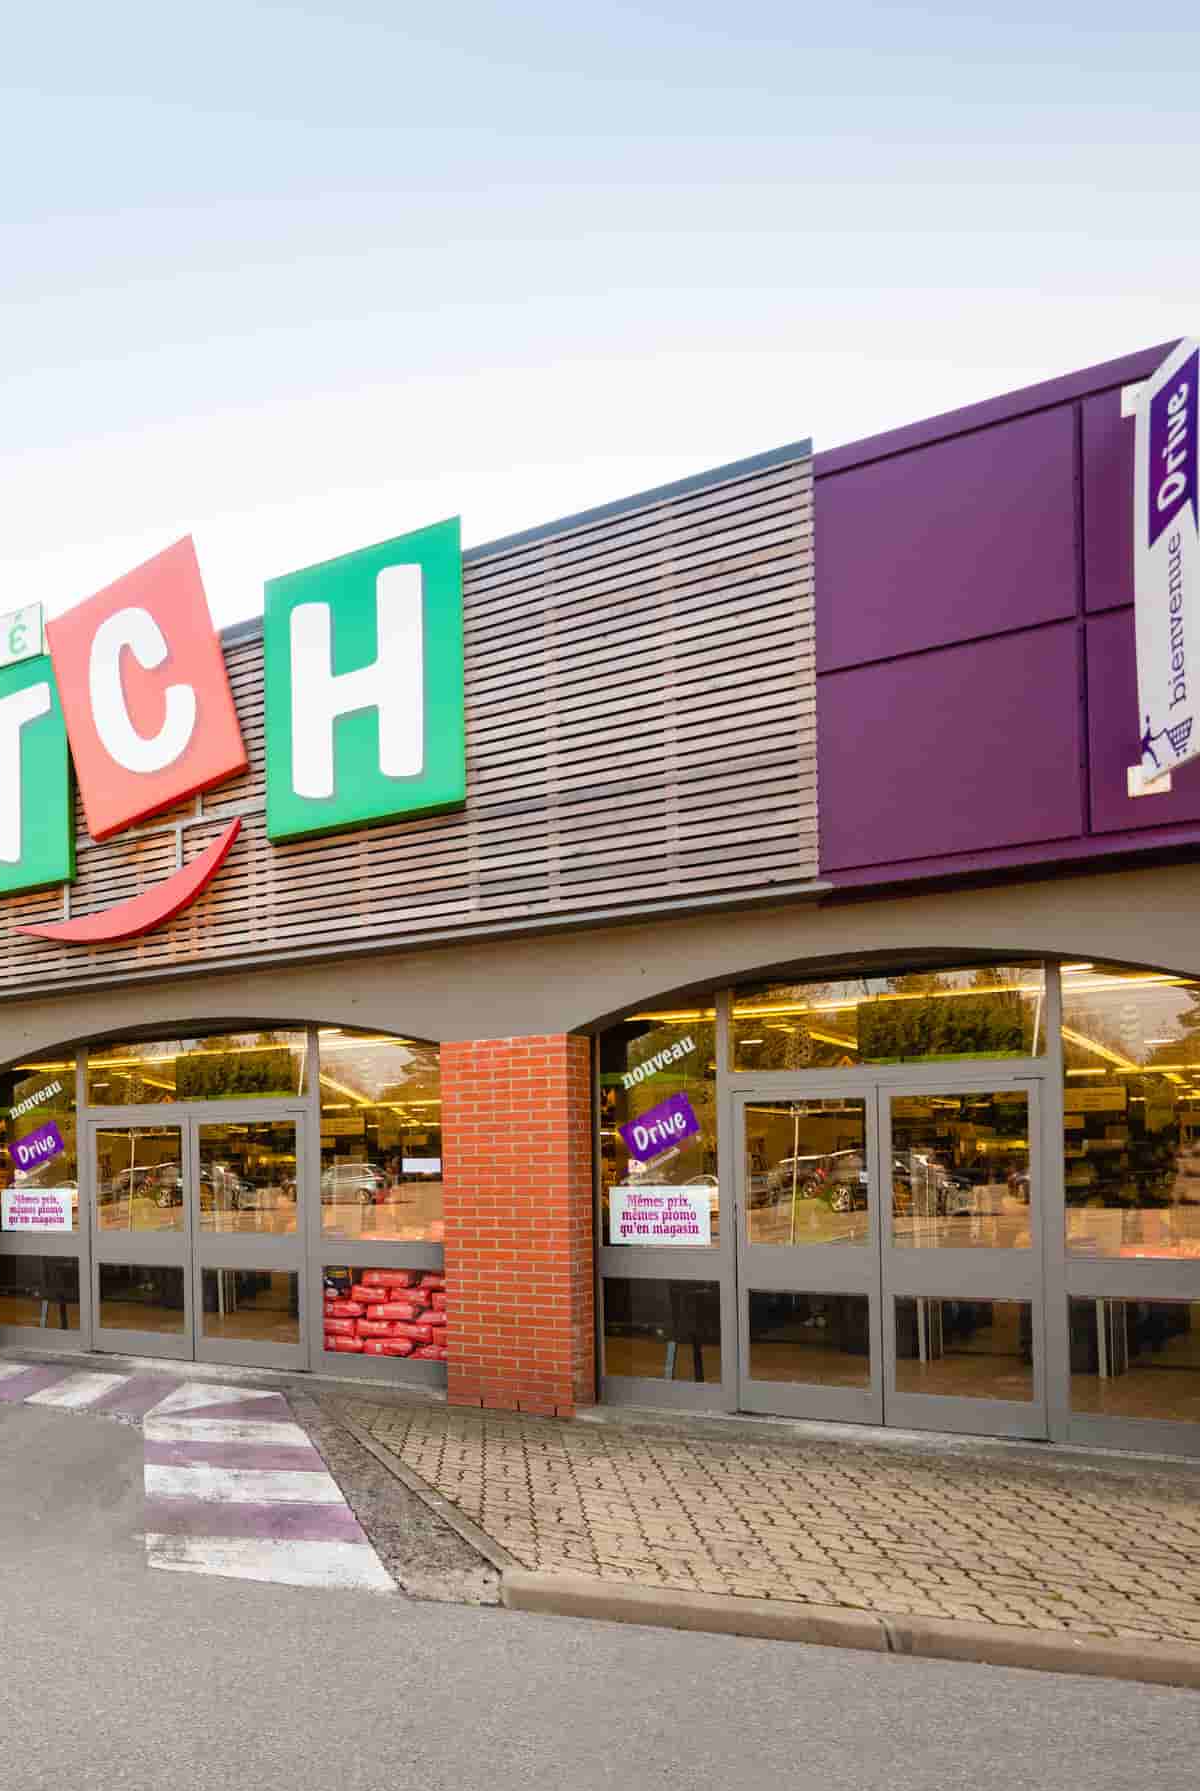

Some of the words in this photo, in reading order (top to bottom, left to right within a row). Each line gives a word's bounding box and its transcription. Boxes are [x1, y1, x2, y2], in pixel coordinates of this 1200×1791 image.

[1157, 383, 1189, 512] Drive
[1168, 531, 1187, 711] bienvenue
[621, 1035, 696, 1089] nouveau
[9, 1080, 63, 1120] nouveau
[17, 1135, 56, 1164] Drive
[633, 1112, 687, 1152] Drive
[652, 1222, 699, 1237] magasin
